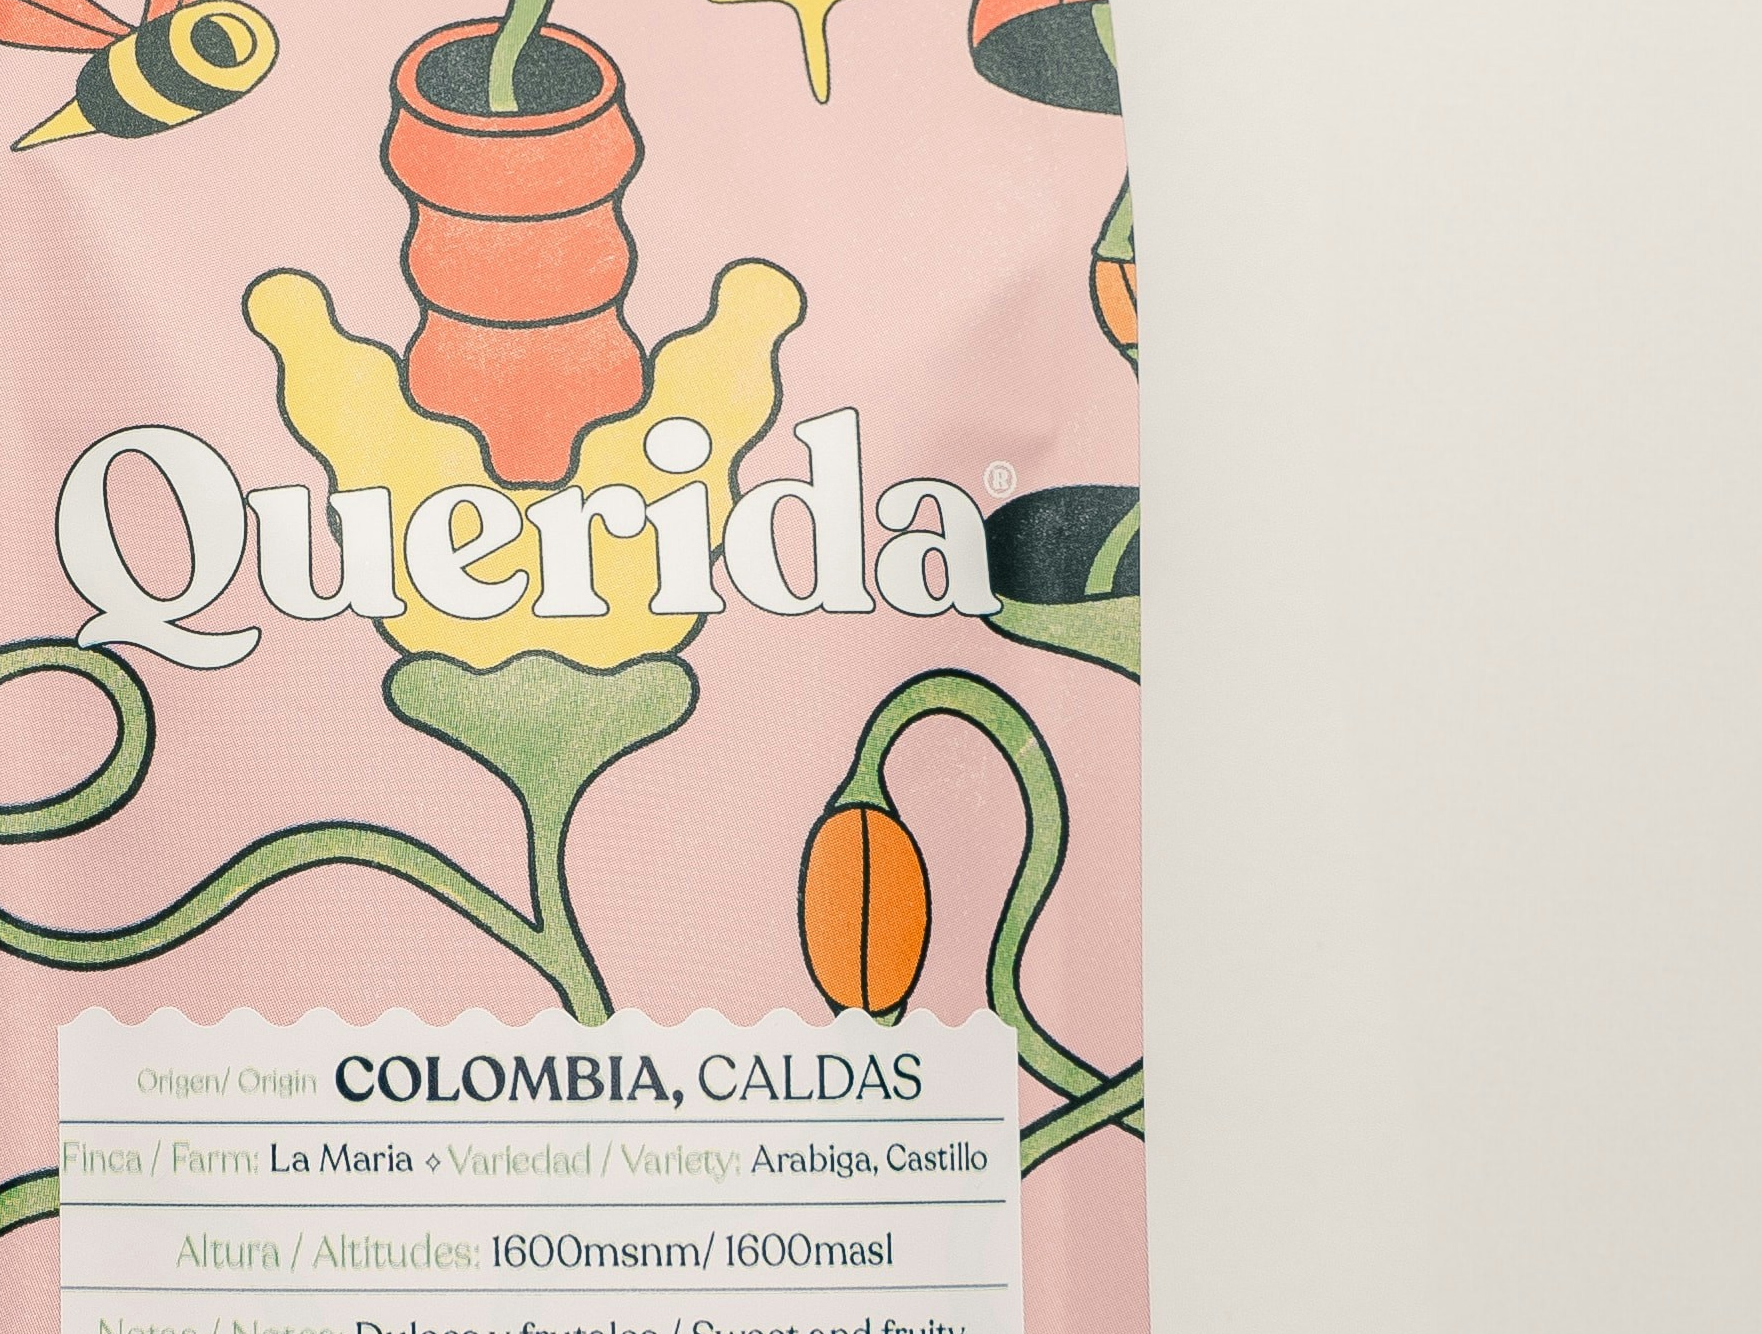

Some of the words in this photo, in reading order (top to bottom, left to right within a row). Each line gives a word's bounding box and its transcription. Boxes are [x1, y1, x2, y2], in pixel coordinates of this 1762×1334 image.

[335, 1055, 684, 1109] COLOMBIA,
[699, 1053, 921, 1101] CALDAS
[62, 1141, 143, 1174] Finca
[171, 1139, 260, 1175] Farm:
[271, 1143, 310, 1172] La
[320, 1143, 413, 1172] Maria
[448, 1144, 590, 1175] Variedad
[621, 1144, 741, 1184] Variety:
[752, 1144, 878, 1178] Arabiga,
[887, 1142, 987, 1172] Castillo
[177, 1233, 280, 1269] Altura
[313, 1233, 481, 1270] Altitudes:
[493, 1232, 714, 1270] 1600msnm/
[727, 1232, 892, 1266] 1600masl
